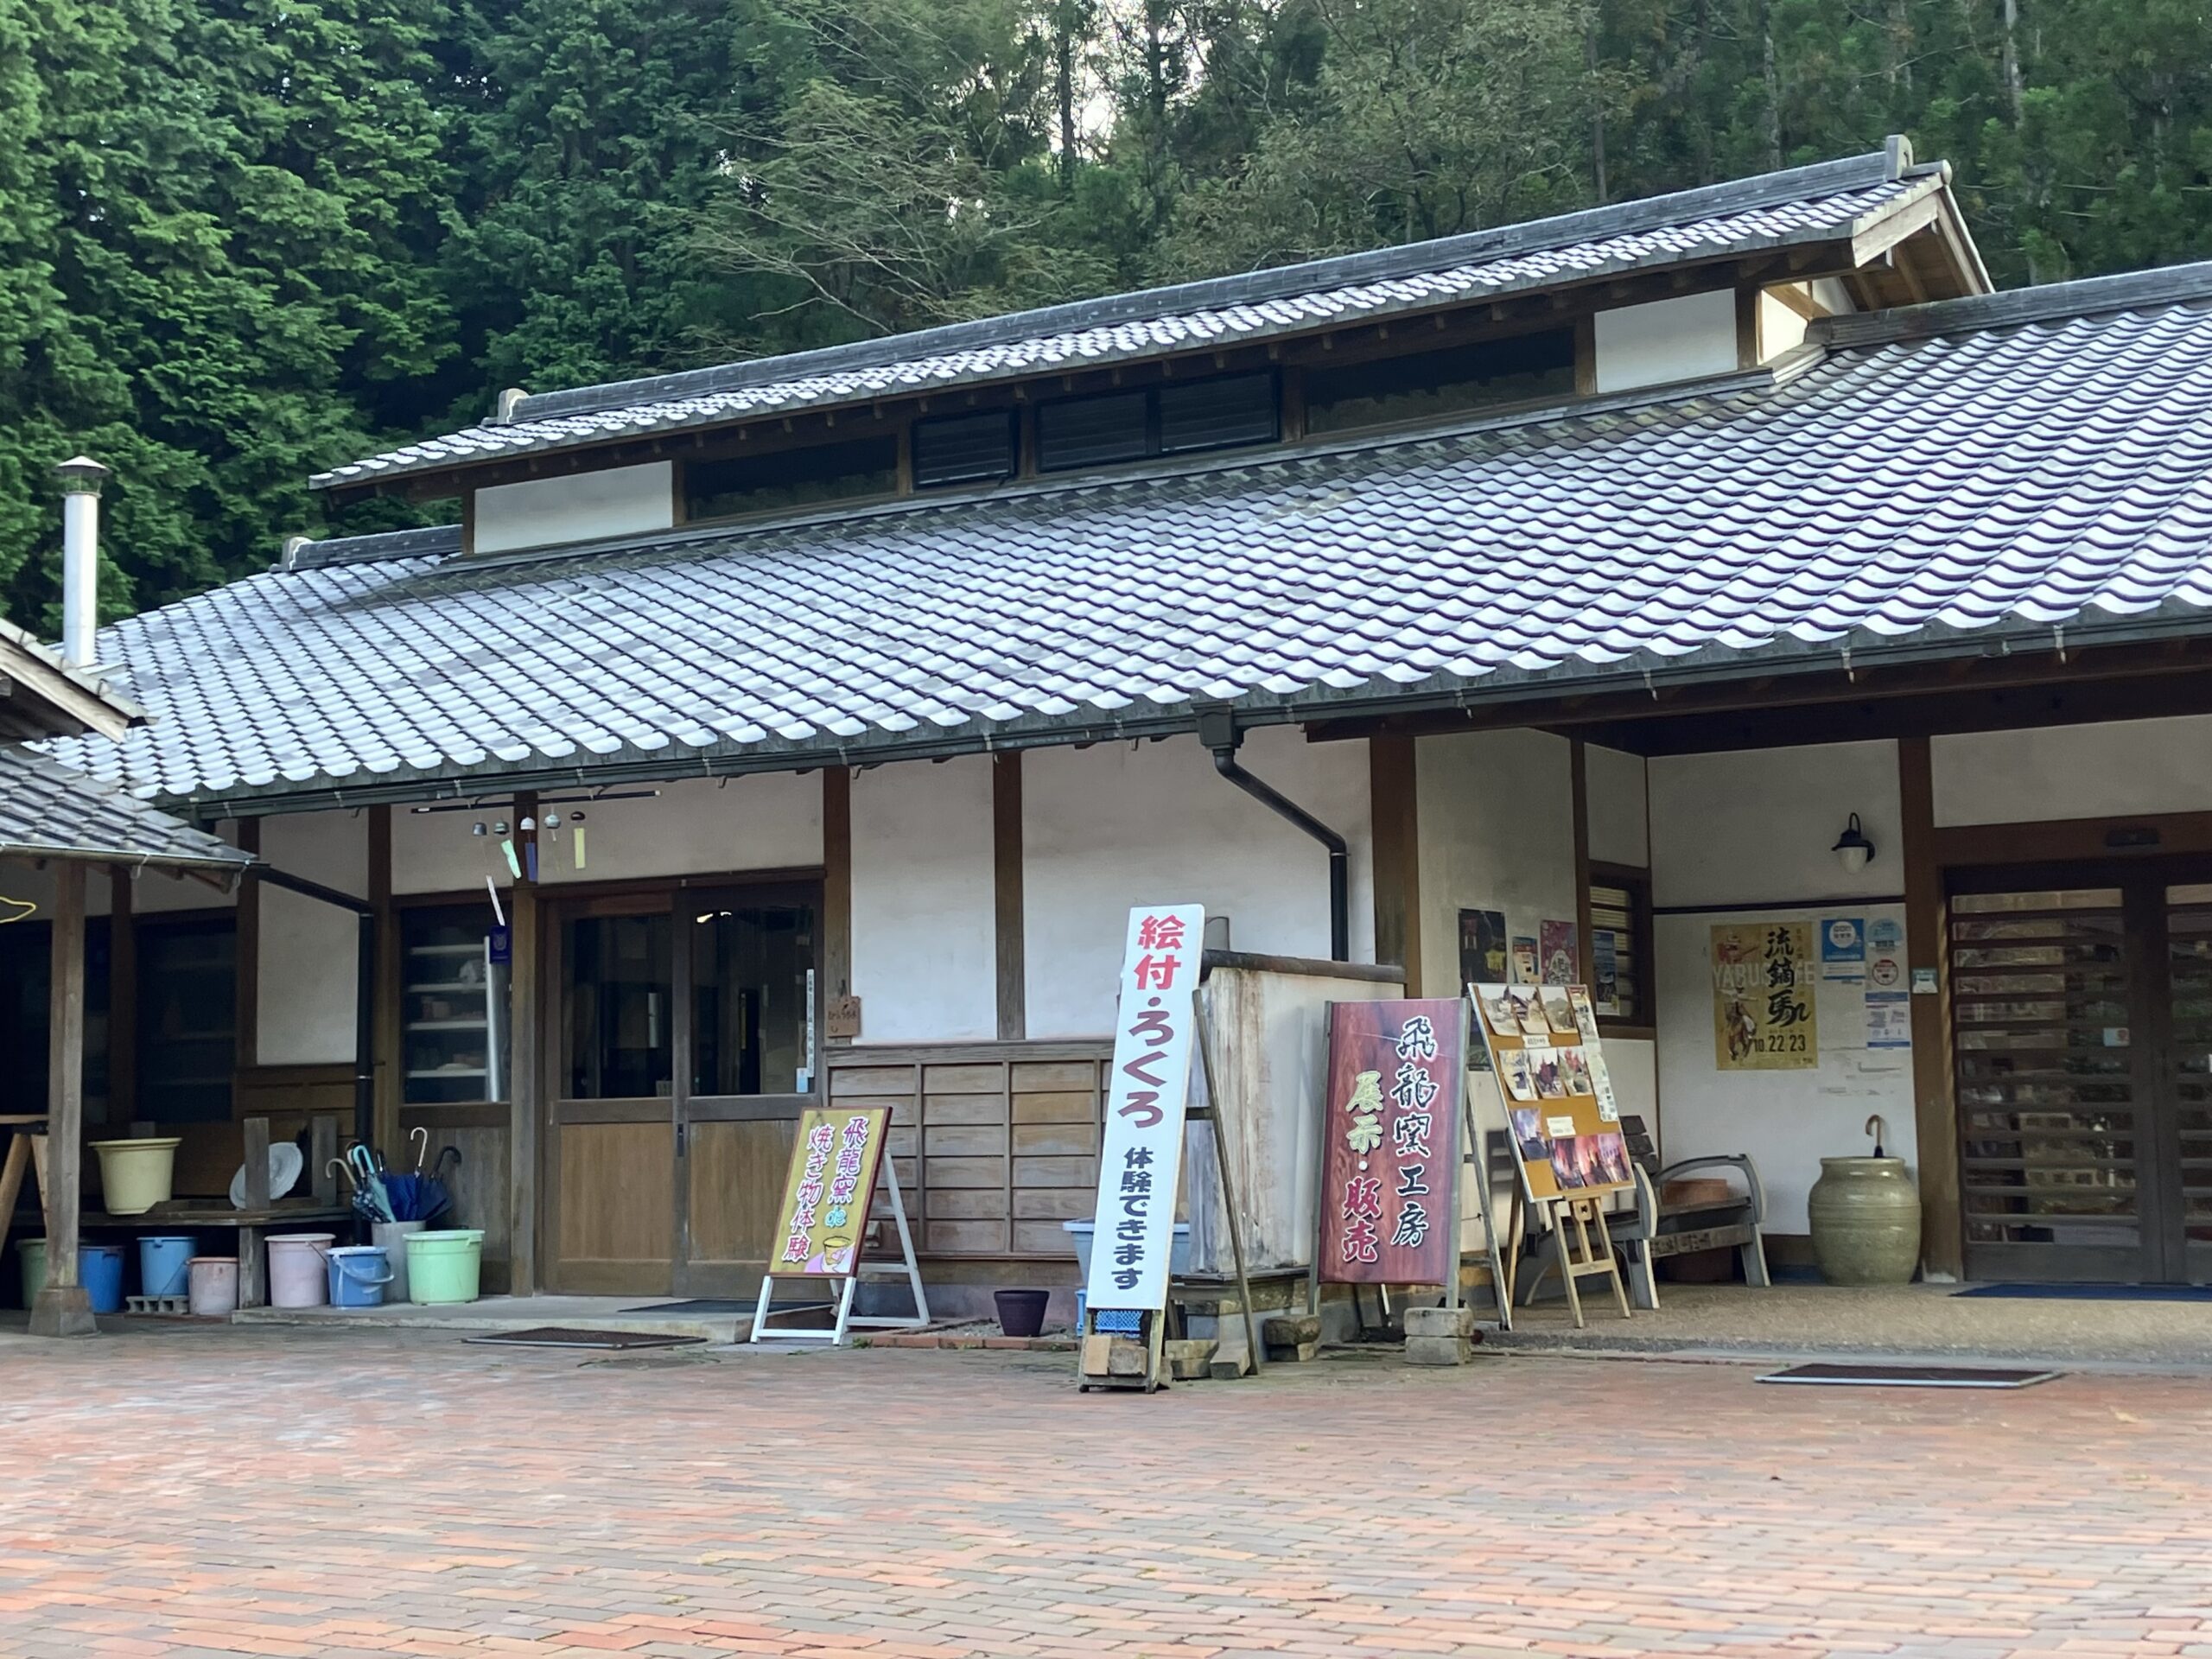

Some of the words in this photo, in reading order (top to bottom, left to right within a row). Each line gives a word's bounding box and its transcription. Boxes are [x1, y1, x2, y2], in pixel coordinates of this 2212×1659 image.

[1118, 914, 1185, 1128] 絵付・ろくろ
[1713, 961, 1815, 988] YABUSME
[1764, 927, 1810, 1027] 流鏑馬
[782, 1123, 836, 1262] 焼き物体験
[1343, 1071, 1383, 1262] 展示・販売
[1391, 1016, 1438, 1247] 飛龍窯工房
[1111, 1147, 1154, 1289] 体験できます
